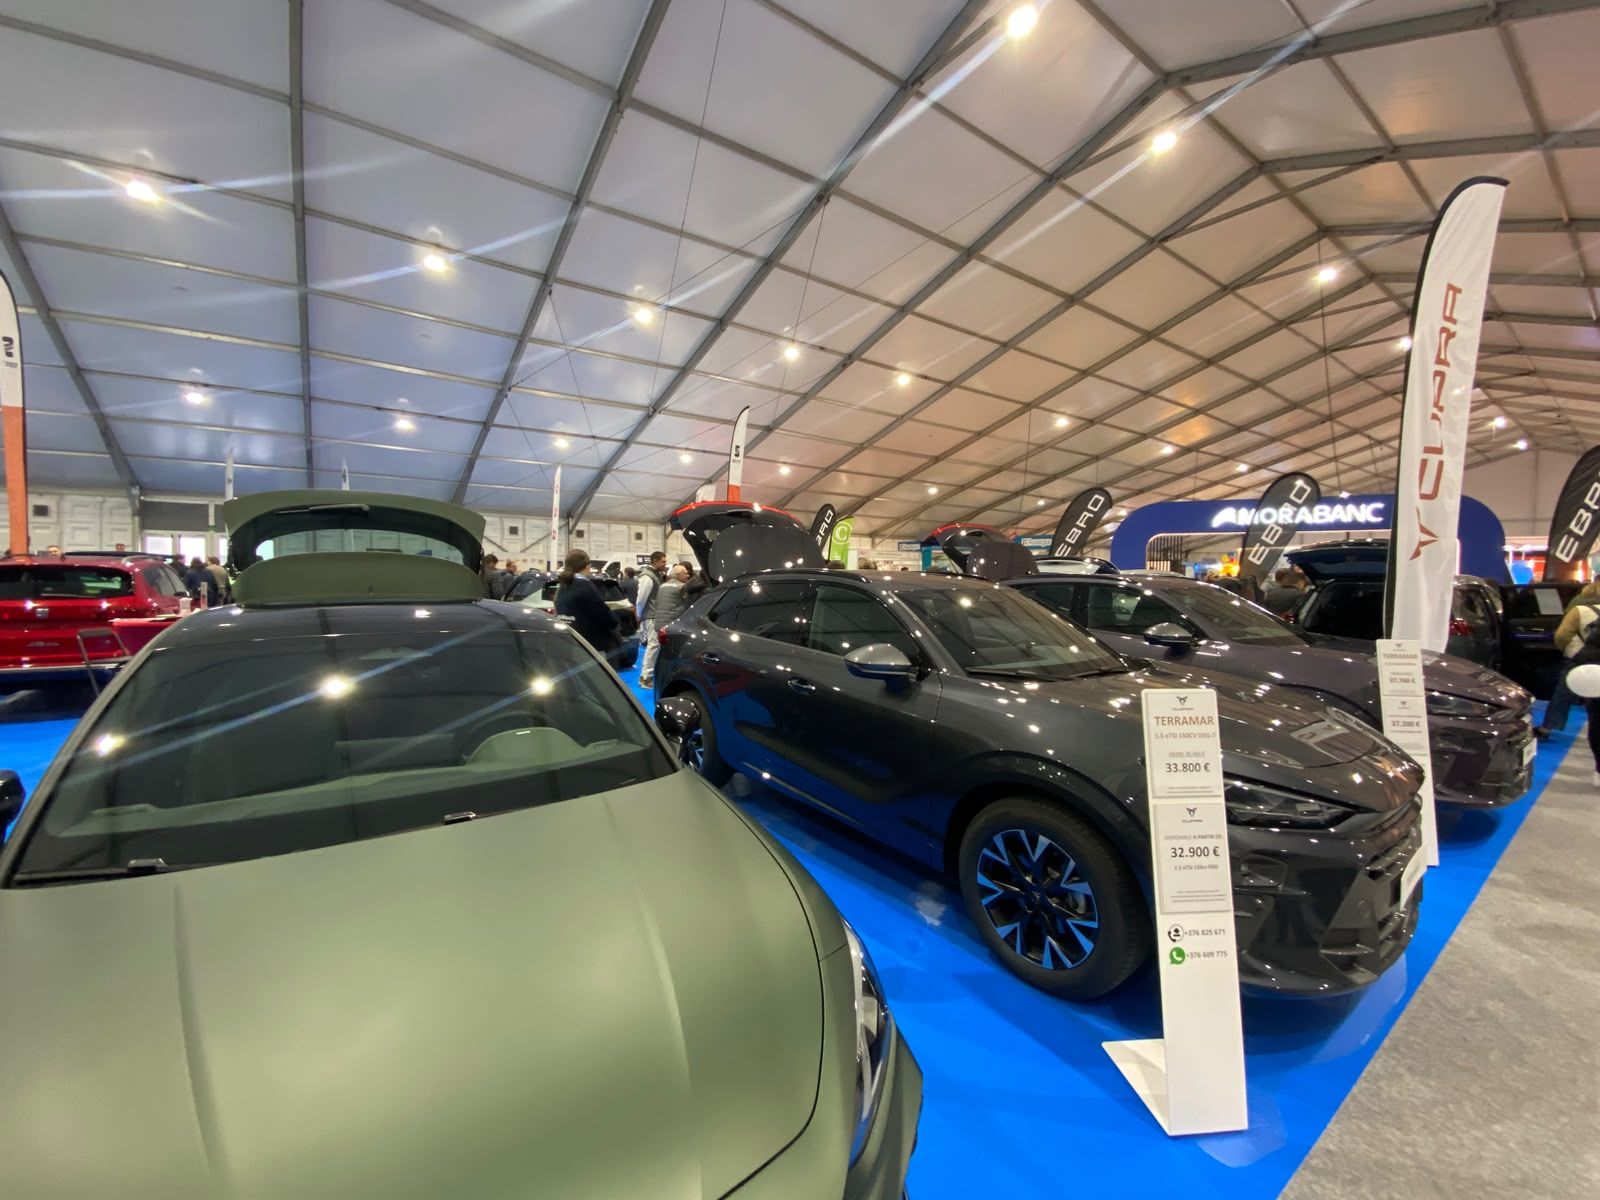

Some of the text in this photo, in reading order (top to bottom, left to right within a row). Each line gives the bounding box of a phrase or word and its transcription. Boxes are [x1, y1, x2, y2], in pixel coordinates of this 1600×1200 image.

[1417, 282, 1463, 501] CUPRA
[1054, 494, 1105, 557] EBRO
[1555, 471, 1600, 563] EBR
[1154, 716, 1215, 726] TERRAMAR
[1166, 762, 1211, 773] 33.800 €
[1171, 846, 1220, 858] 32.900 €
